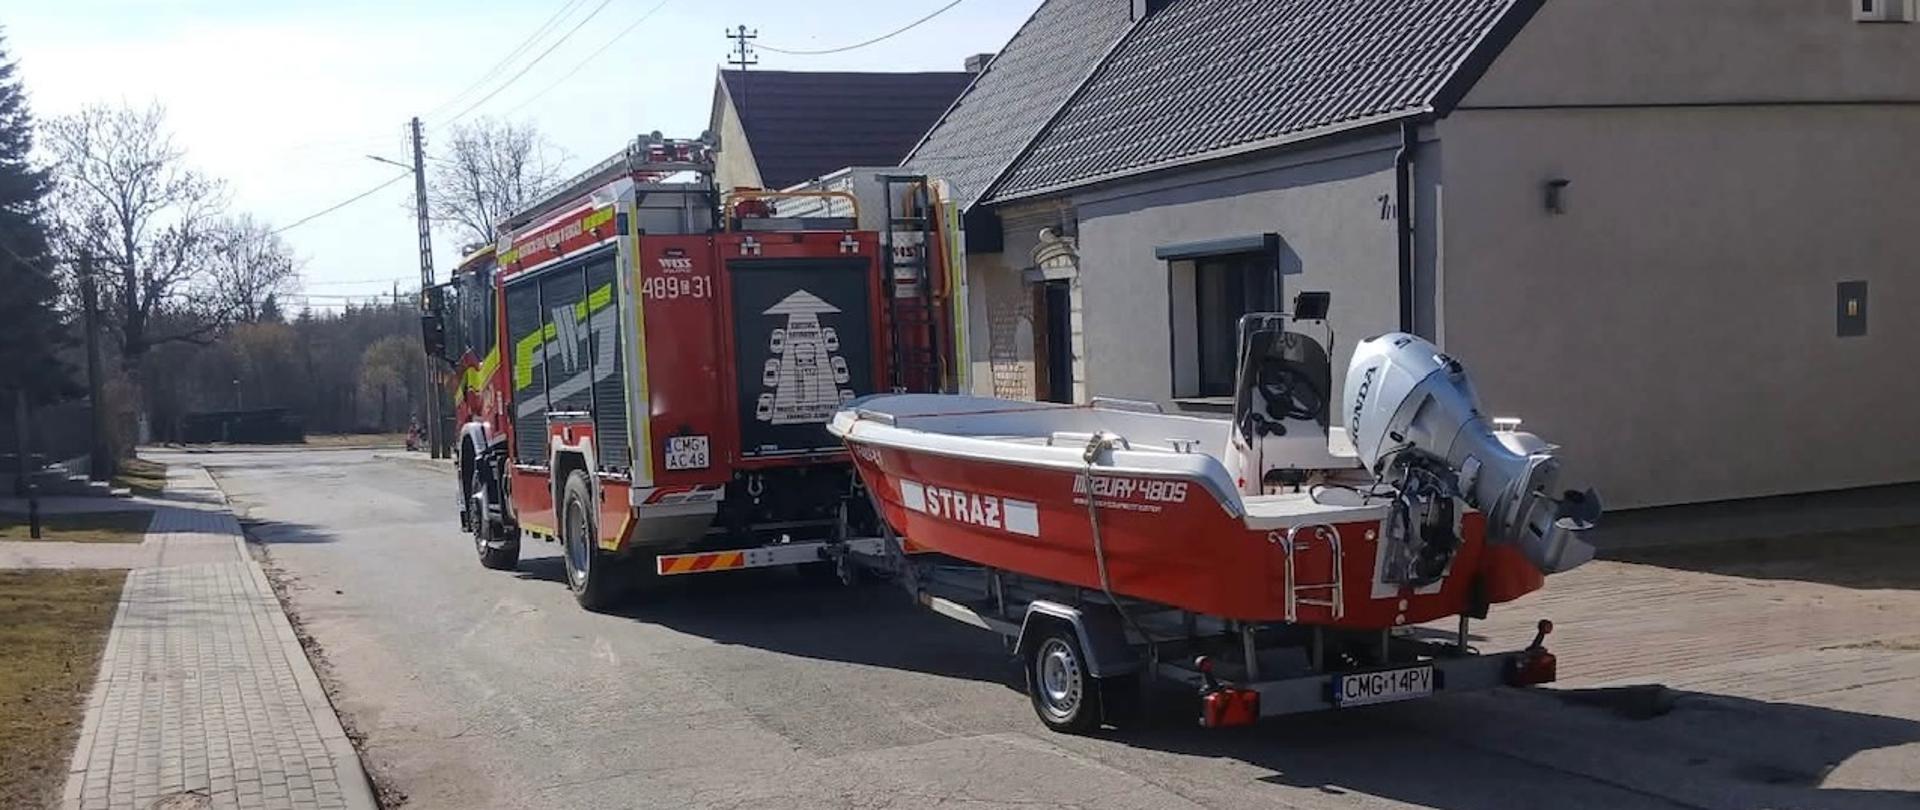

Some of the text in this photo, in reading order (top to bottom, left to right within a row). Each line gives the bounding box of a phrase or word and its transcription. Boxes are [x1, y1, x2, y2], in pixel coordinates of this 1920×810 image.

[642, 277, 679, 299] 489
[692, 276, 712, 298] 31
[1350, 366, 1379, 448] HONDA
[673, 438, 700, 452] CMG
[670, 452, 706, 468] AC48
[1073, 474, 1137, 499] MZURY
[1345, 668, 1431, 698] CMG 14PV
